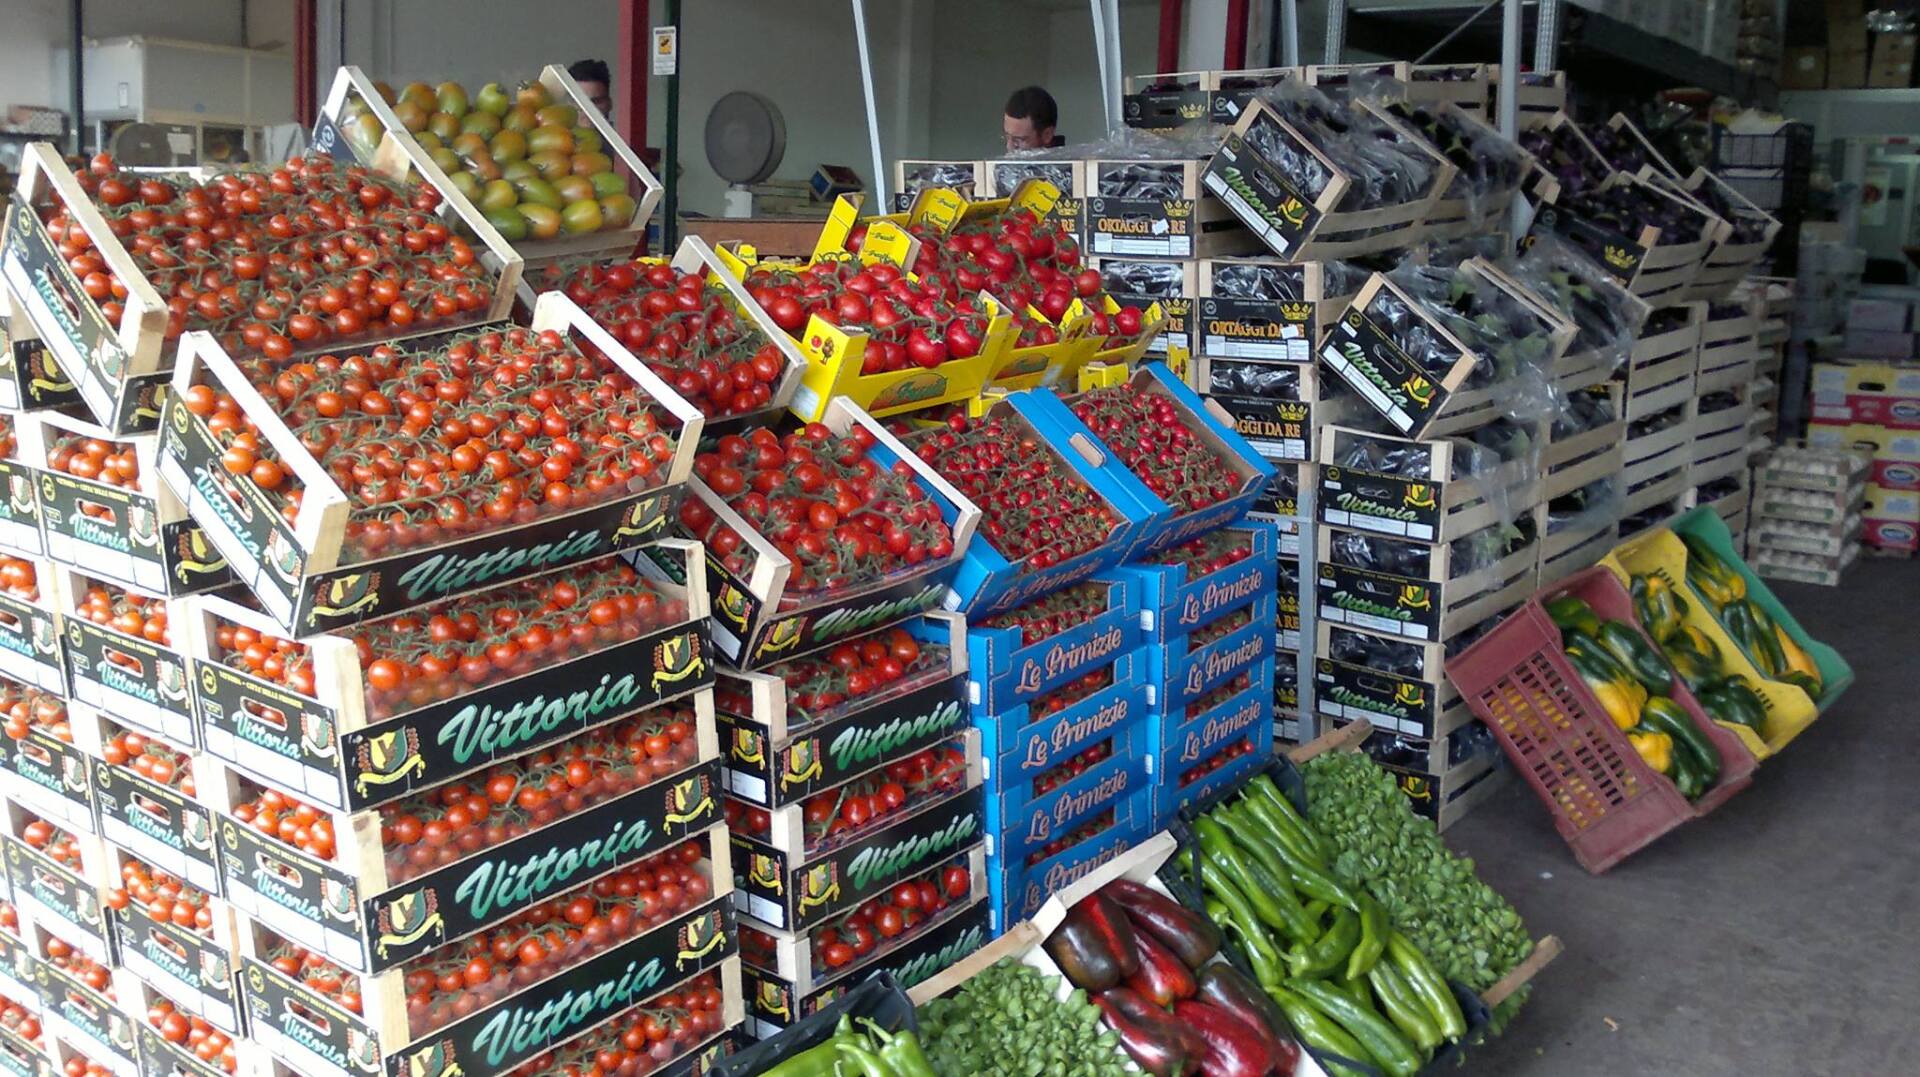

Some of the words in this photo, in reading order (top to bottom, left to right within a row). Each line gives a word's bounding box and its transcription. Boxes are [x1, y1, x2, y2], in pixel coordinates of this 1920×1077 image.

[1224, 166, 1285, 231] Vittoria
[1344, 340, 1409, 409] Vittoria
[1264, 421, 1284, 437] DA
[1284, 423, 1301, 437] RE
[69, 512, 131, 553] Vittoria
[194, 467, 261, 559] Vittoria
[1336, 492, 1419, 521] Vittoria
[397, 529, 602, 600] Vittoria
[812, 582, 945, 642] Vittoria
[1179, 592, 1200, 625] Le
[1202, 568, 1262, 613] Primizie
[1331, 590, 1415, 621] Vittoria
[96, 660, 158, 704] Vittoria
[1015, 658, 1041, 694] Le
[1045, 625, 1122, 681] Primizie
[1183, 663, 1203, 695] Le
[1206, 634, 1264, 682] Primizie
[438, 672, 641, 765] Vittoria
[1180, 731, 1200, 763] Le
[1203, 700, 1261, 749] Primizie
[1330, 685, 1411, 718] Vittoria
[231, 709, 302, 760] Vittoria
[829, 700, 962, 771] Vittoria
[1021, 734, 1048, 769] Le
[1051, 697, 1128, 753] Primizie
[124, 803, 184, 850] Vittoria
[1025, 809, 1050, 844] Le
[1053, 768, 1127, 828] Primizie
[454, 818, 653, 920] Vittoria
[846, 812, 978, 890] Vittoria
[252, 869, 322, 922] Vittoria
[142, 937, 201, 989] Vittoria
[279, 1012, 349, 1068] Vittoria
[472, 956, 666, 1067] Vittoria
